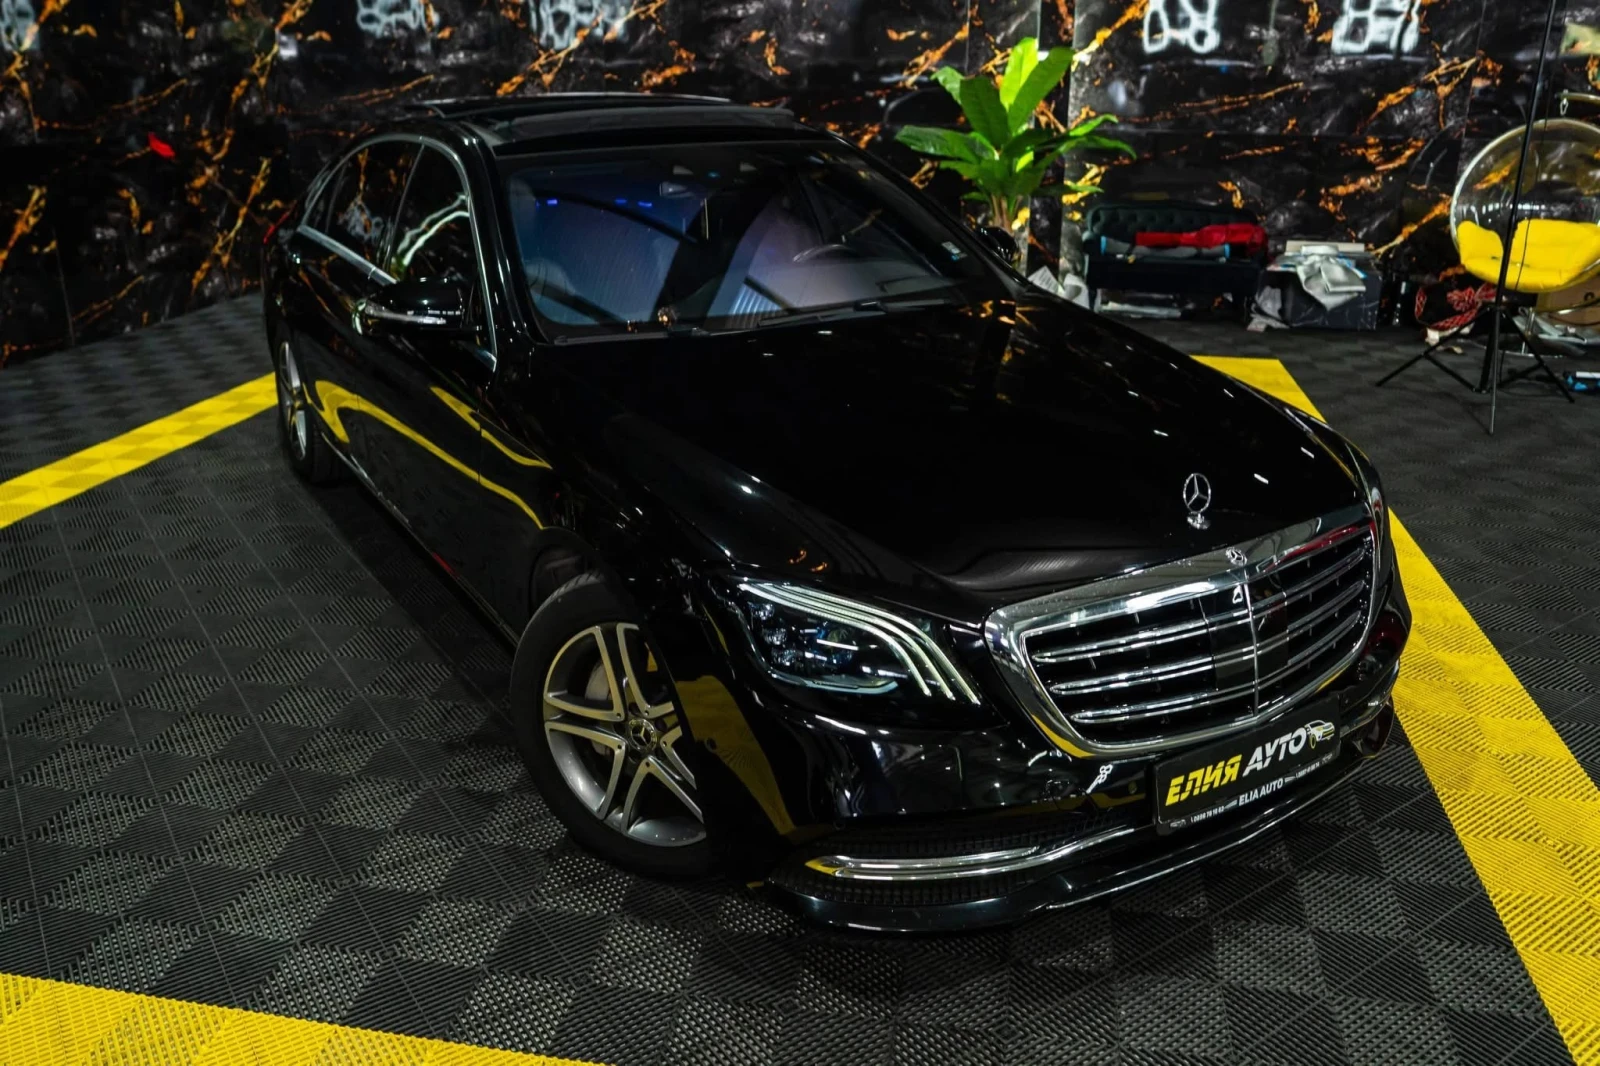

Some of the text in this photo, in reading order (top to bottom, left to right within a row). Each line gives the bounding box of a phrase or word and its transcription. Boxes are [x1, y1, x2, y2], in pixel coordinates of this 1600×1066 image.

[1165, 754, 1242, 806] ЕЛИЯ
[1238, 778, 1284, 806] ELIA AUTO
